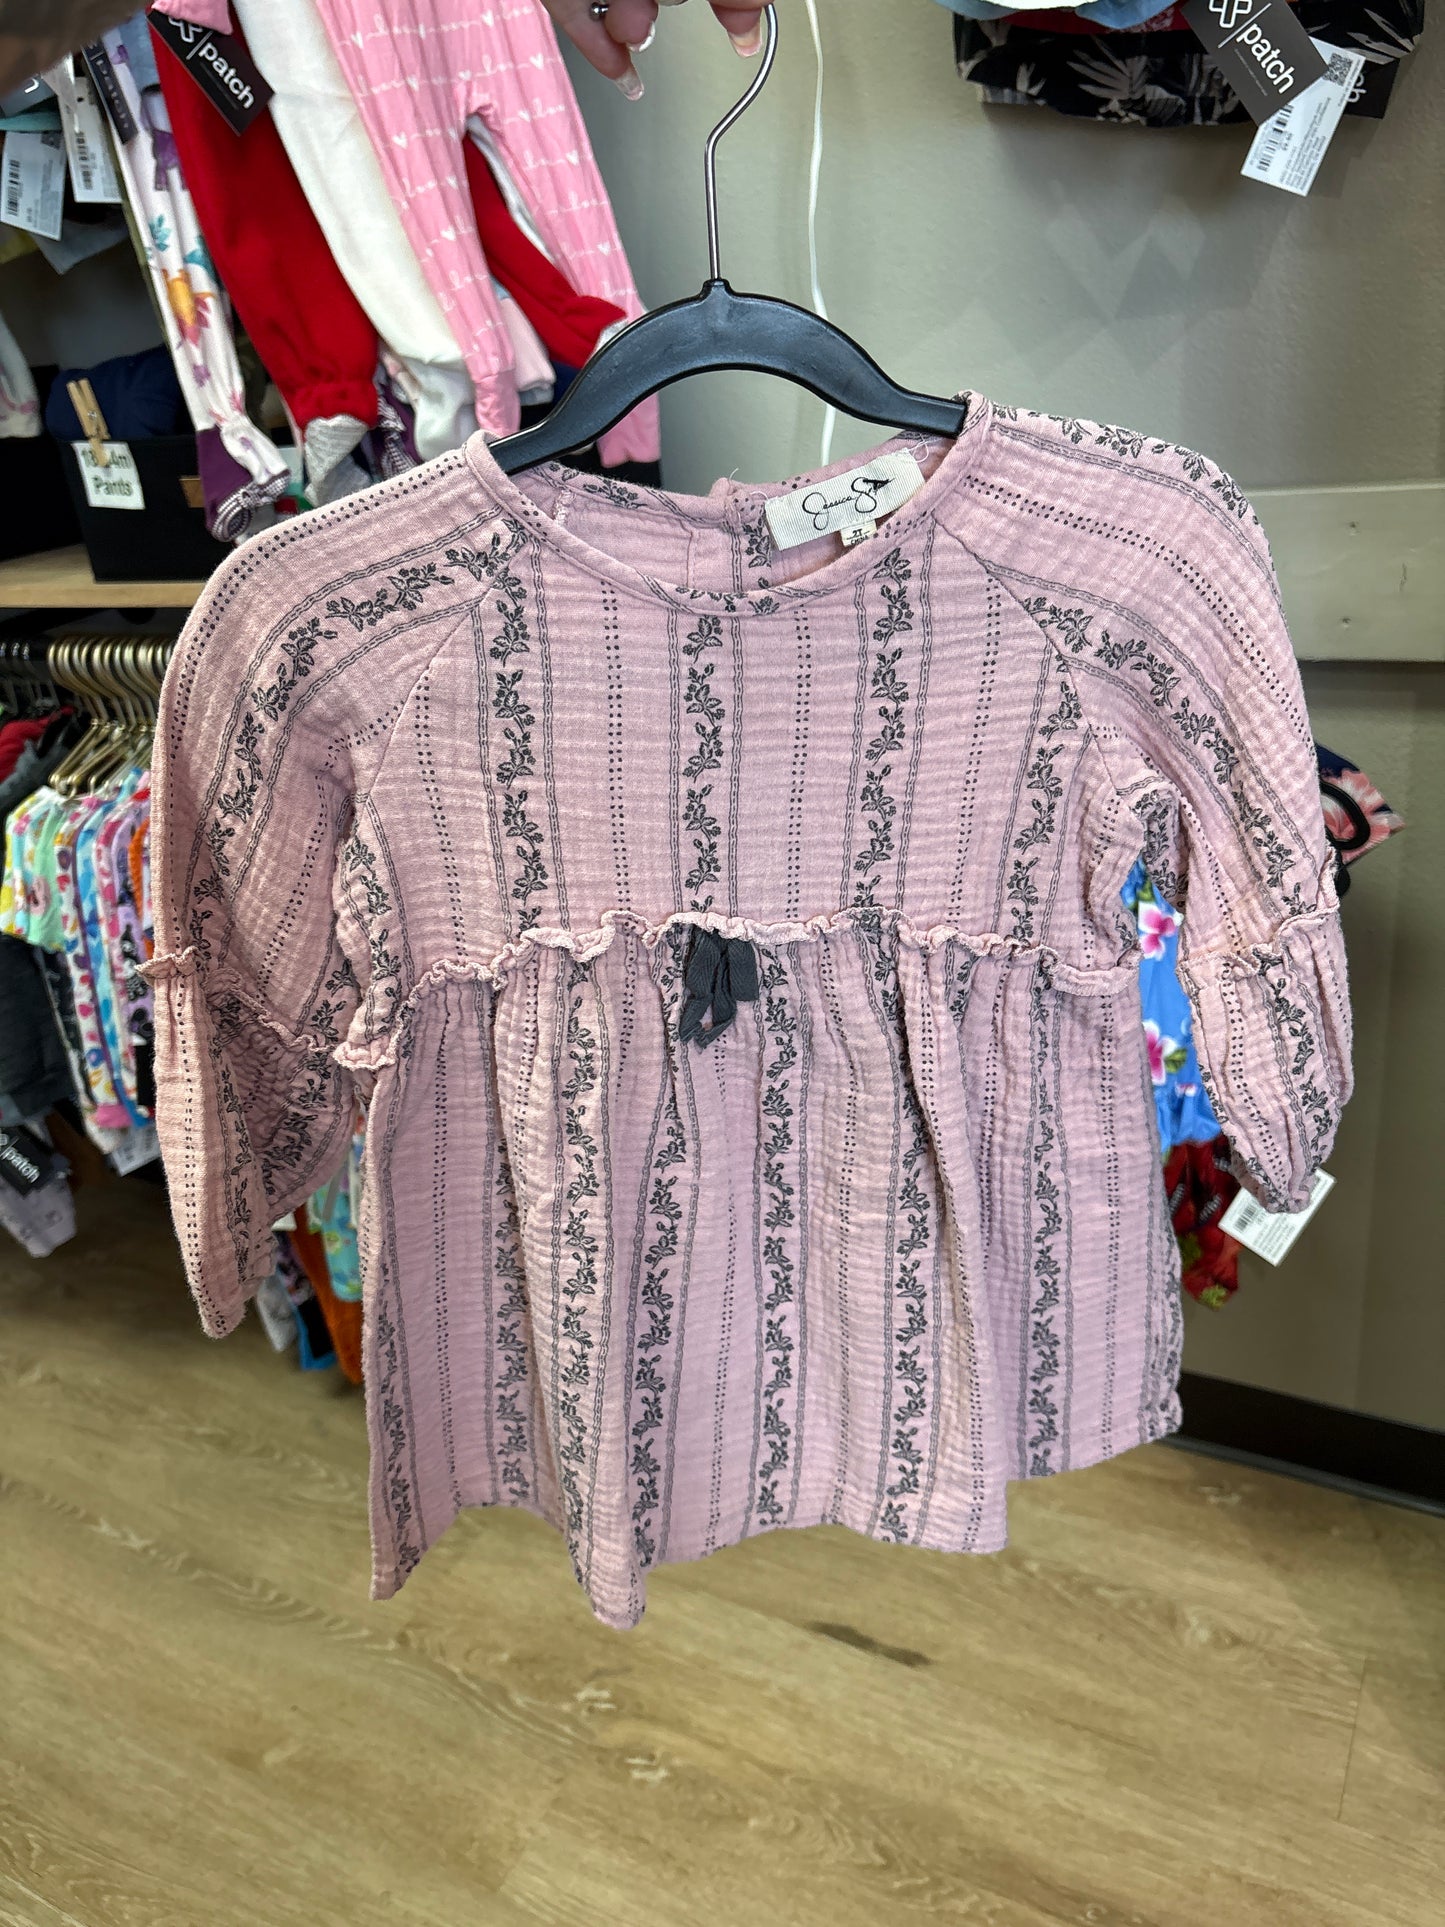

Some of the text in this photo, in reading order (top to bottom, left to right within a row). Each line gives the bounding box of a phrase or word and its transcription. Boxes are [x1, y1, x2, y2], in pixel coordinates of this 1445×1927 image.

[198, 42, 254, 109] patch
[1236, 23, 1295, 94] patch
[852, 528, 863, 537] 2T
[2, 1146, 40, 1183] patch
